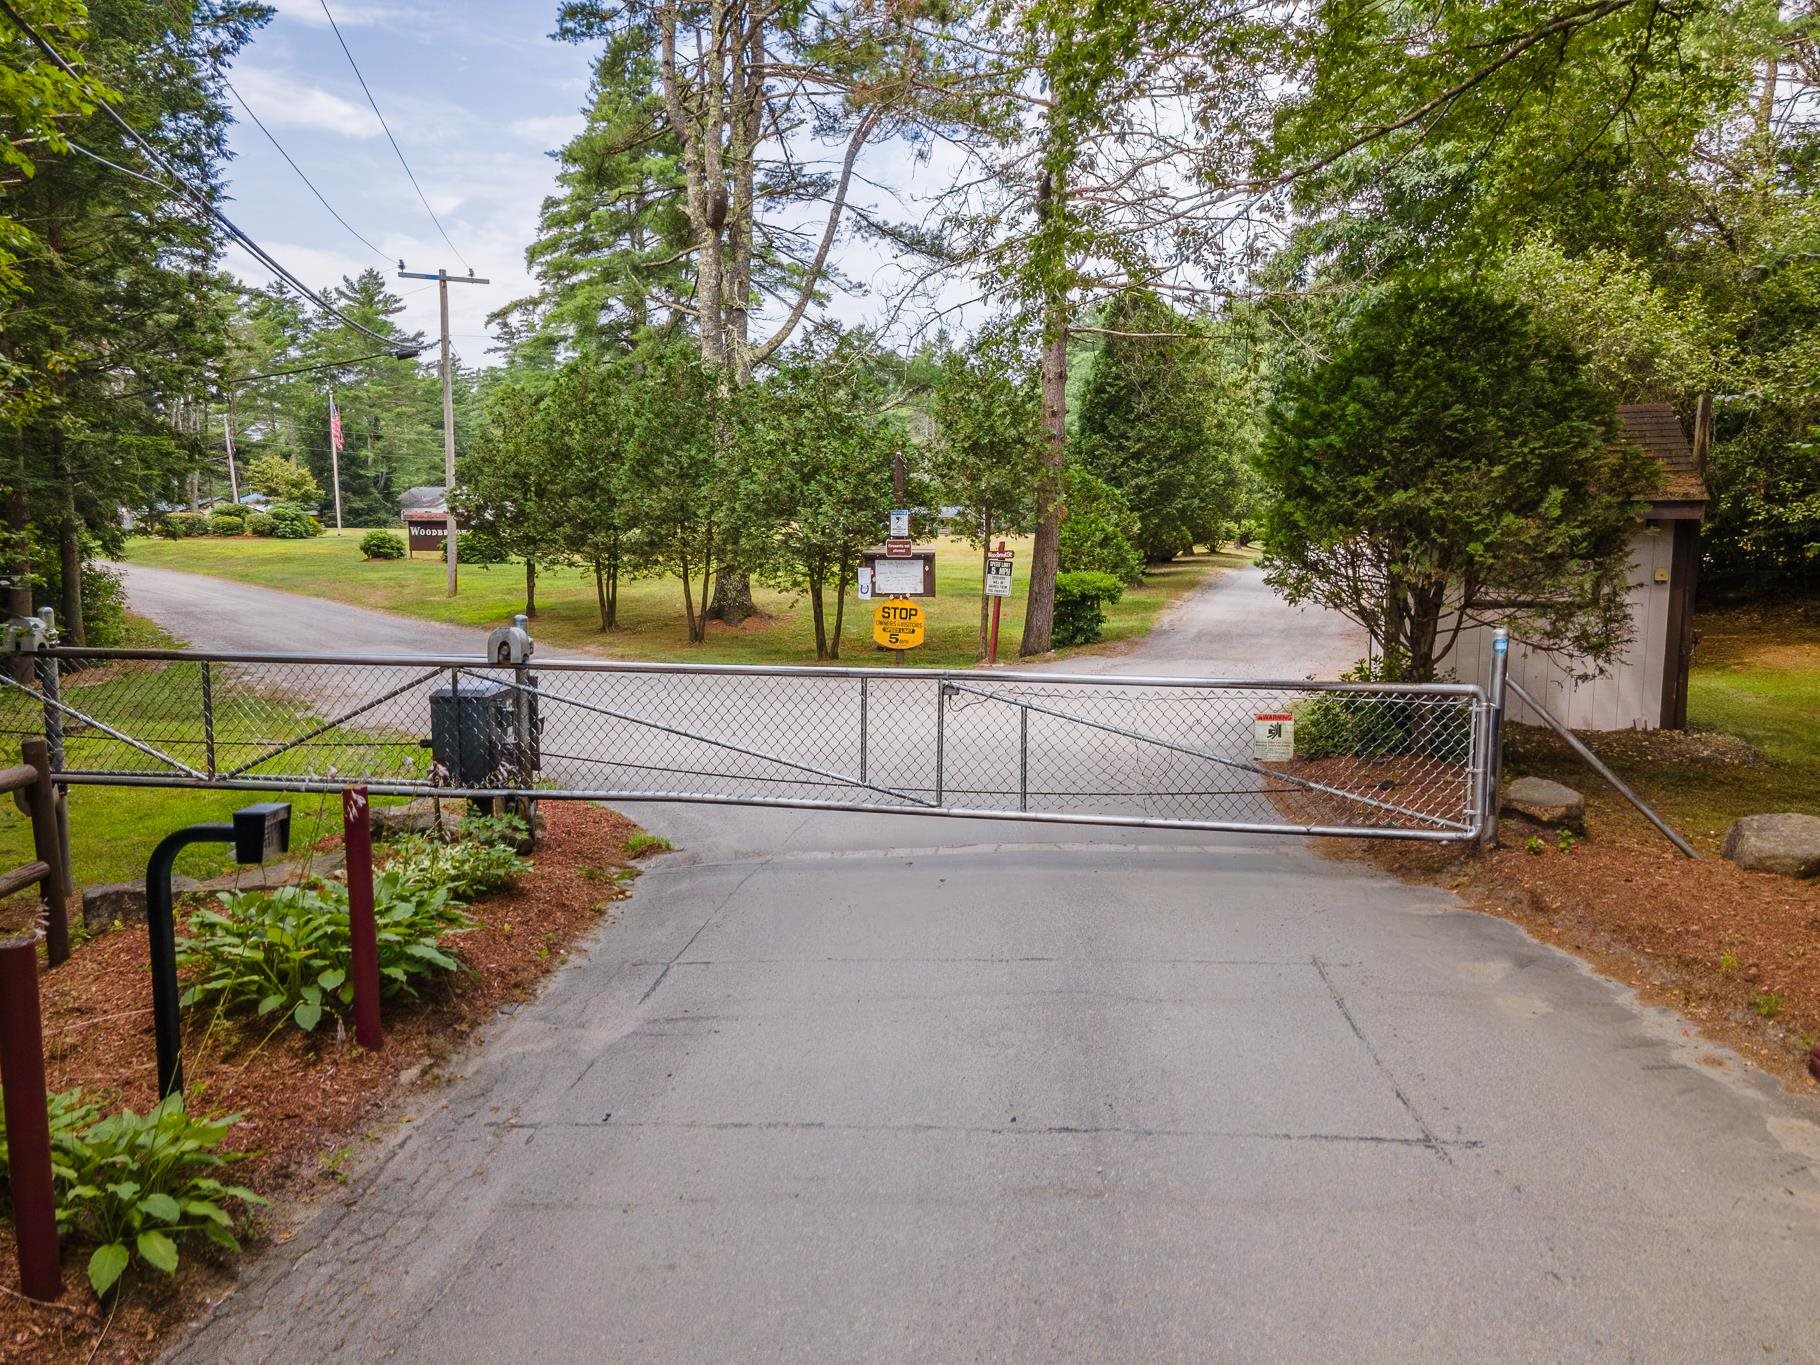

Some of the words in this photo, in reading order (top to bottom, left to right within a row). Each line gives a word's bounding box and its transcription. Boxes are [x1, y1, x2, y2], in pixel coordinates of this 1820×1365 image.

[991, 567, 996, 575] 5
[881, 606, 918, 620] STOP
[888, 634, 899, 644] 5
